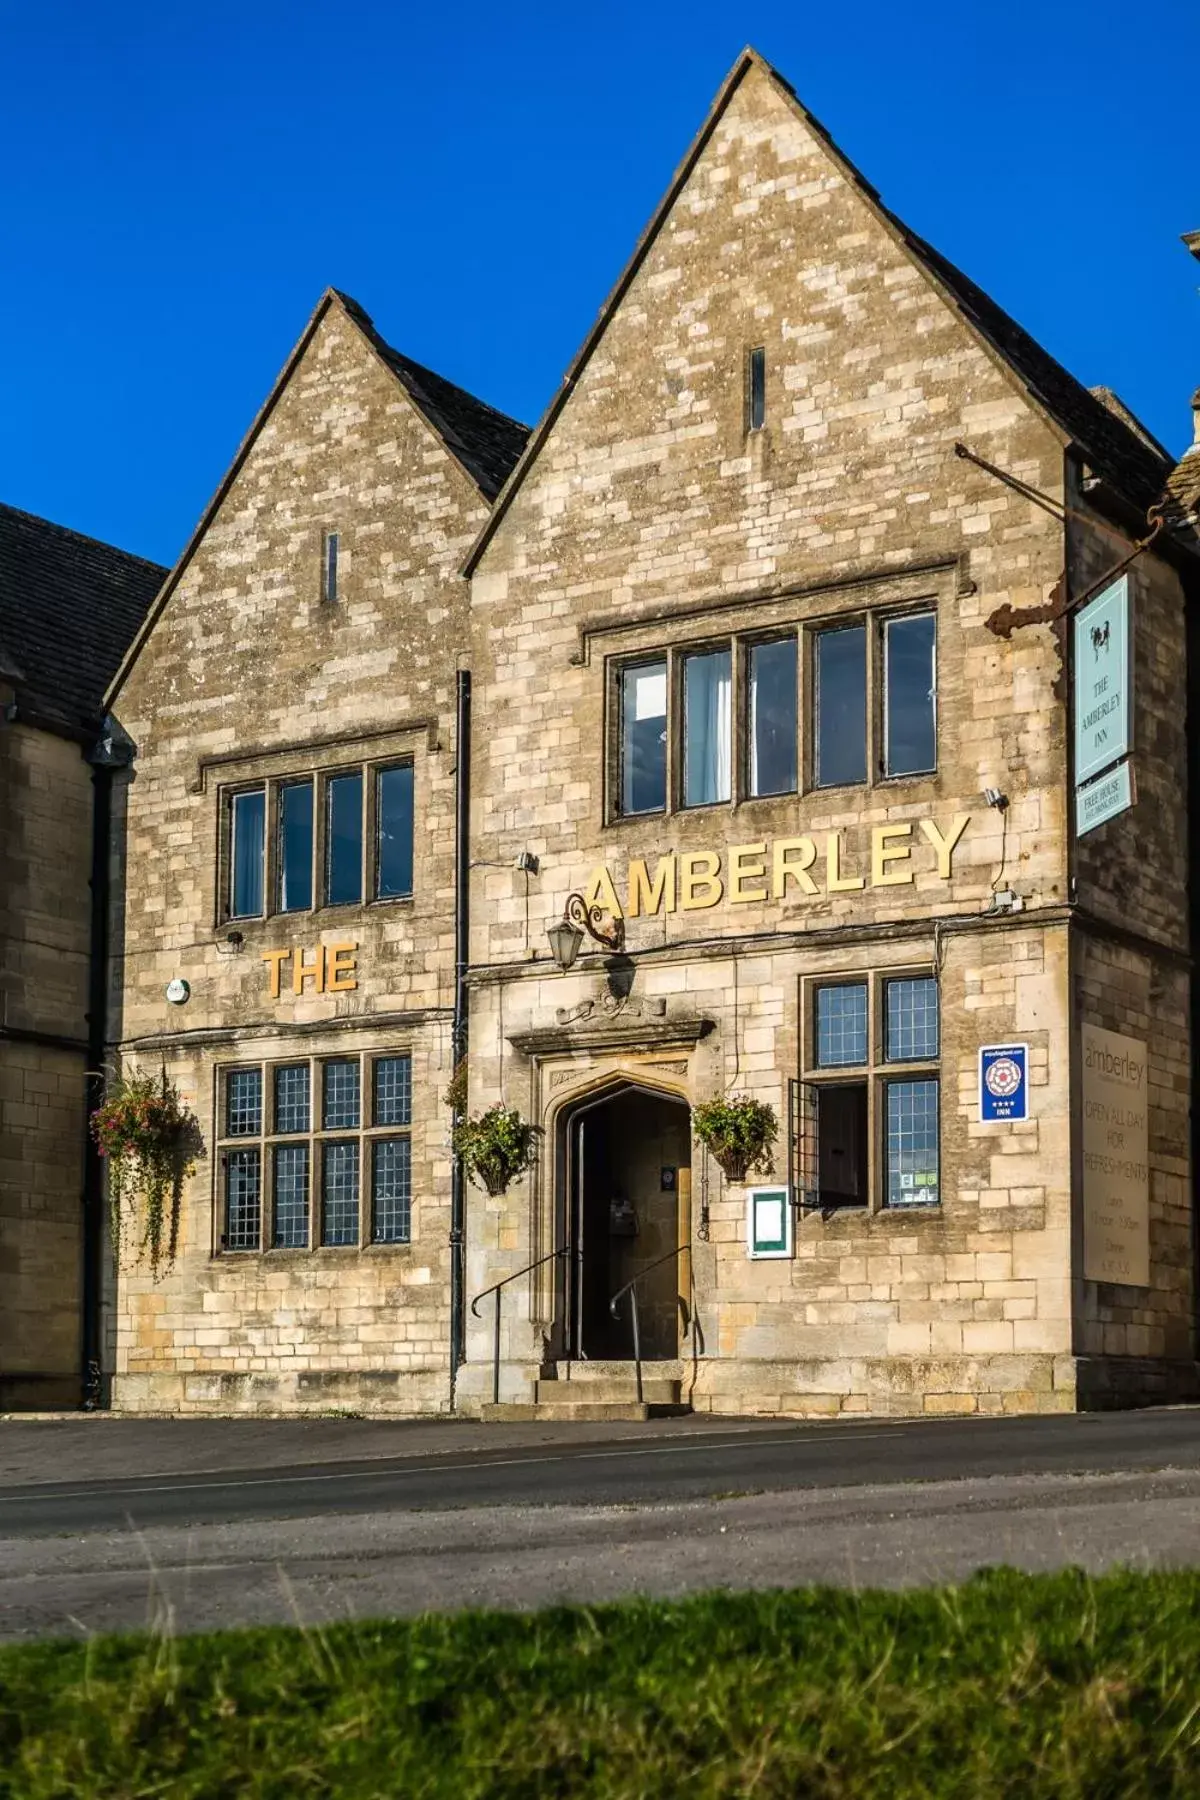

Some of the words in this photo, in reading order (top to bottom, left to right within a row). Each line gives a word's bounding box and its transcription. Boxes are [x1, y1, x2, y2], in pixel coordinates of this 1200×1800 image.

[1092, 675, 1109, 698] THE
[1081, 690, 1122, 733] AMBERLEY
[1093, 727, 1108, 748] INN
[584, 815, 972, 921] AMBERLEY
[260, 942, 359, 999] THE
[1085, 1043, 1145, 1090] amberley
[996, 1108, 1011, 1116] INN
[1086, 1100, 1109, 1123] OPEN
[1109, 1106, 1126, 1126] ALL
[1127, 1110, 1145, 1130] DAY
[1106, 1129, 1125, 1150] FOR
[1084, 1152, 1149, 1182] REFRESHMENTS
